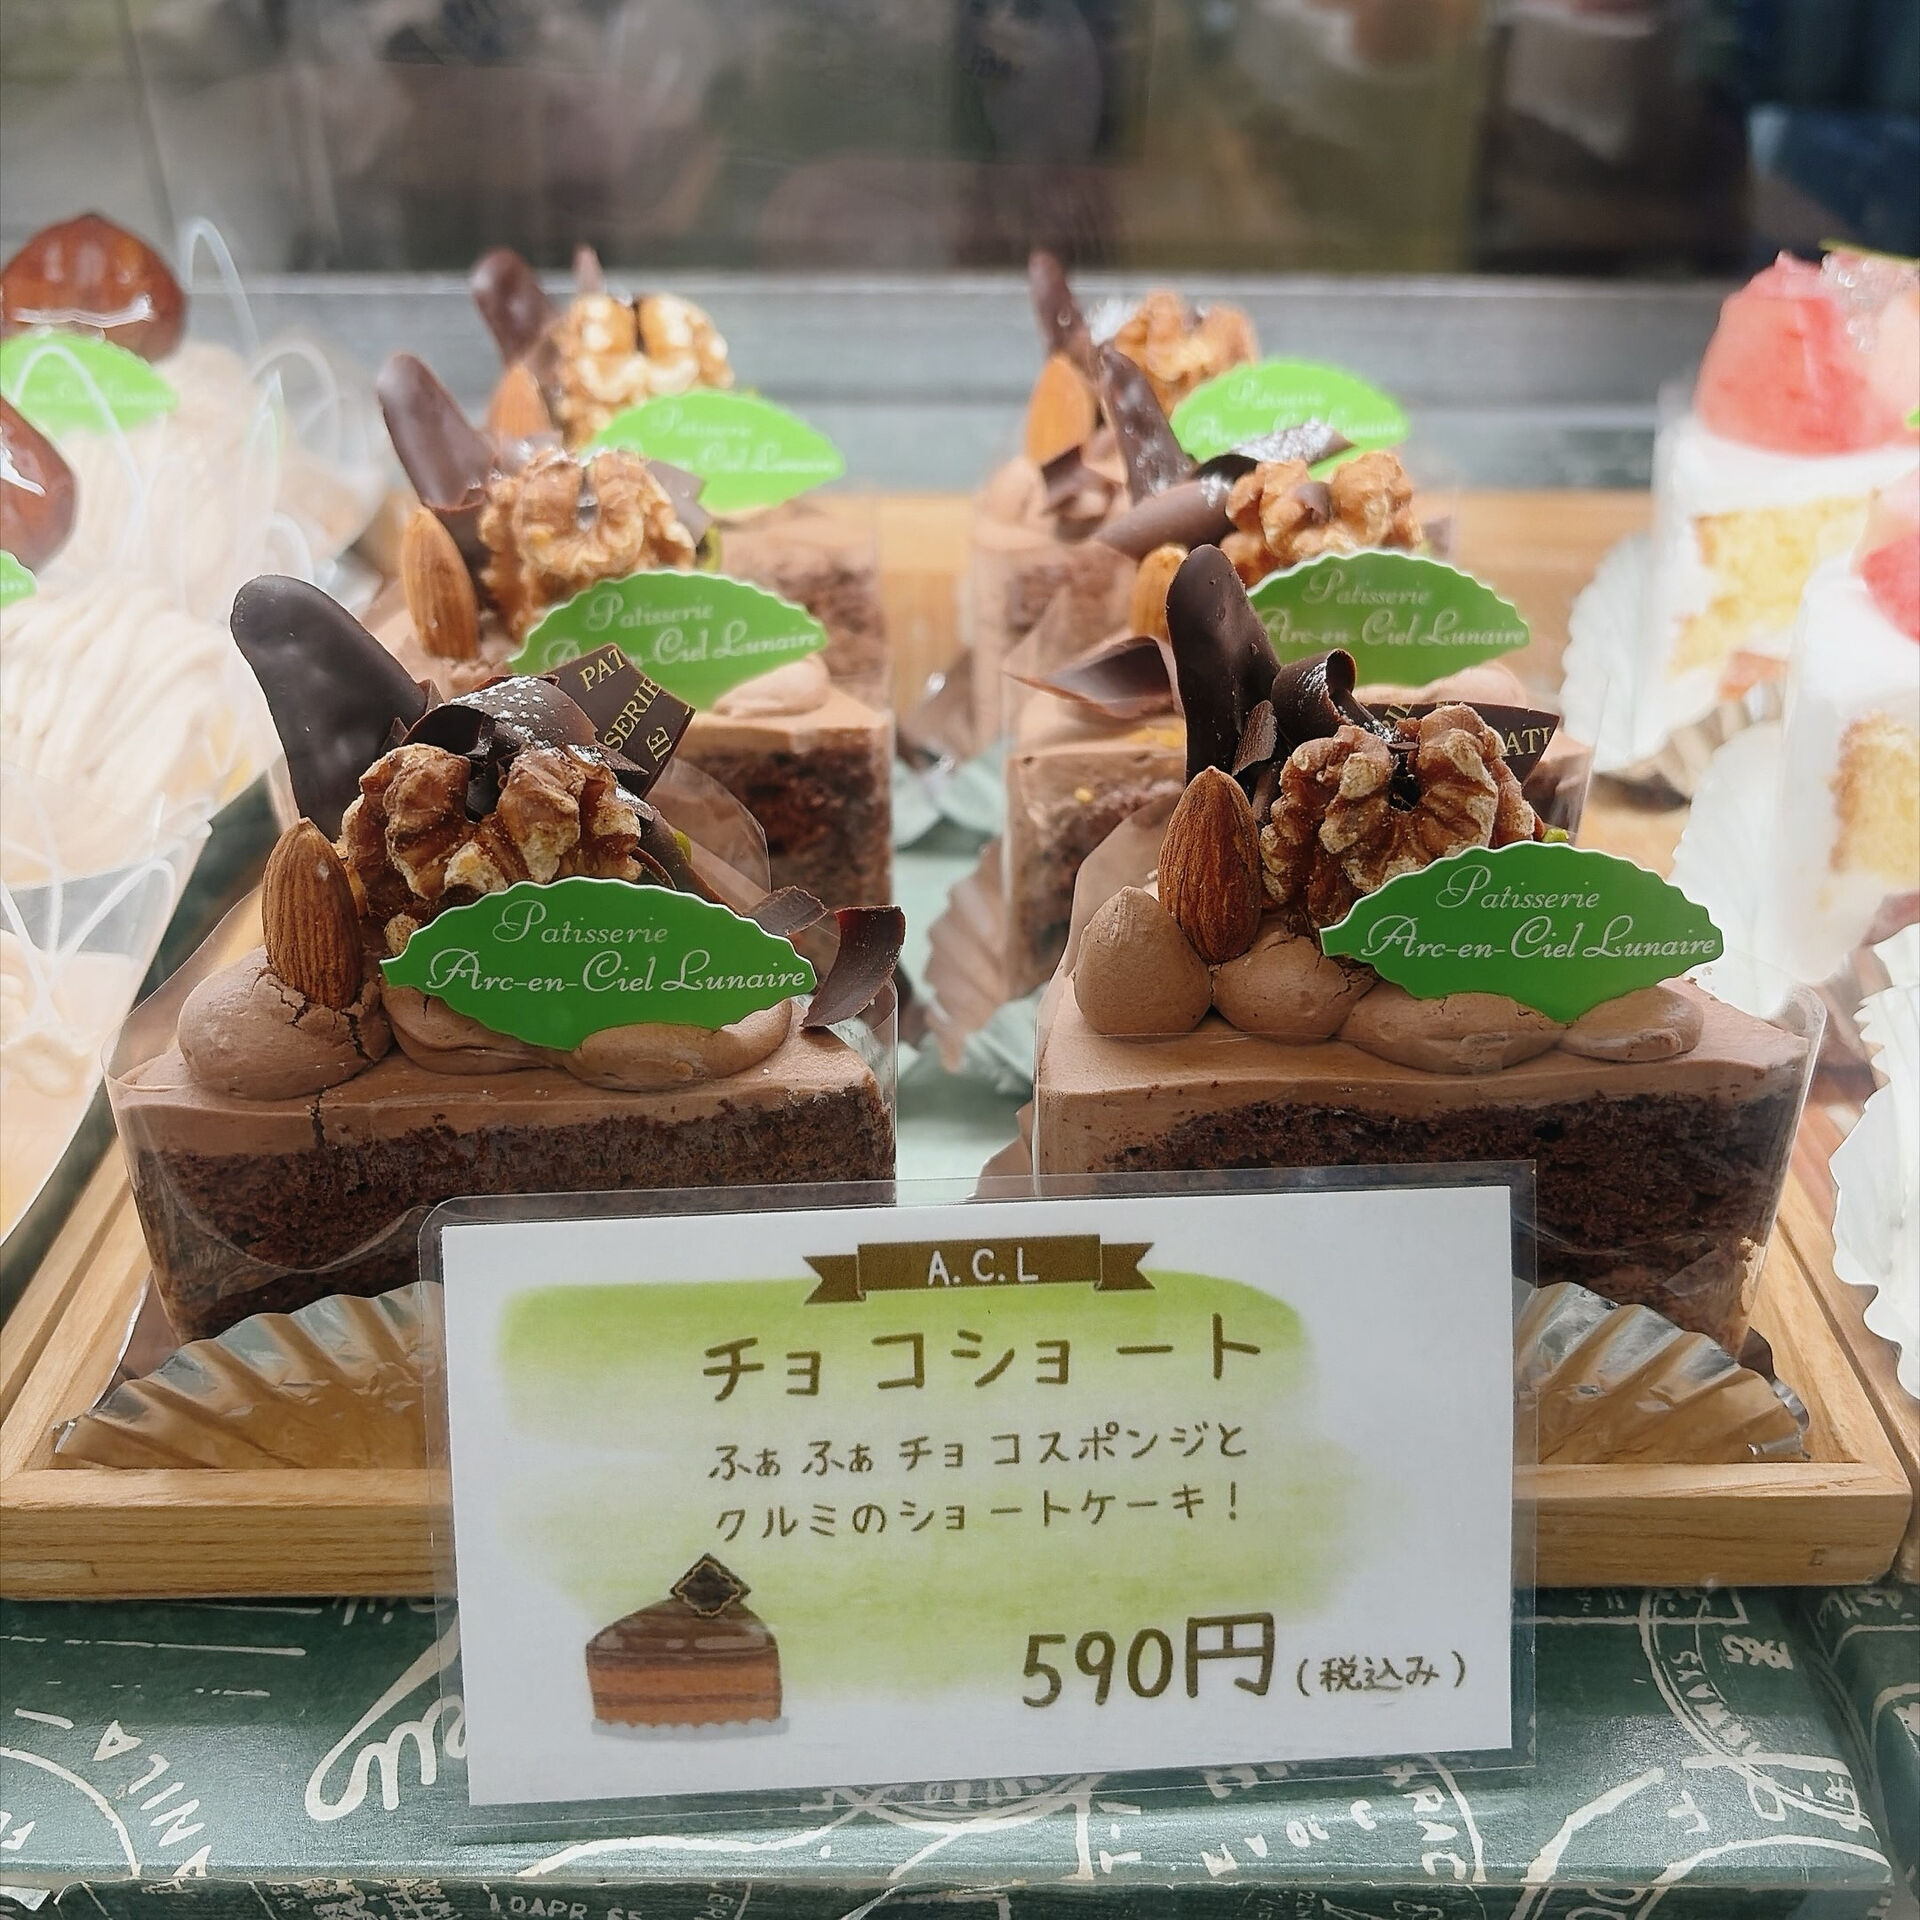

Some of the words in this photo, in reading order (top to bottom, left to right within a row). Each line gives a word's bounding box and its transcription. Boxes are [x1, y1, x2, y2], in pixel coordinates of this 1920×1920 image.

[1303, 565, 1431, 605] Patisserie
[583, 591, 714, 631] Patisserie
[1417, 608, 1526, 647] Lunaire
[712, 619, 820, 657] Lunaire
[1436, 865, 1600, 909] Patisserie
[493, 900, 668, 944] Patisserie
[1360, 915, 1582, 959] Arc-en-Ciel
[1582, 915, 1716, 958] Lunaire
[426, 948, 656, 993] Arc-en-Ciel
[660, 950, 806, 992] Lunaire
[927, 1247, 1038, 1286] A.C.L
[703, 1313, 1260, 1401] チョコショート
[1022, 1612, 1276, 1708] 590円
